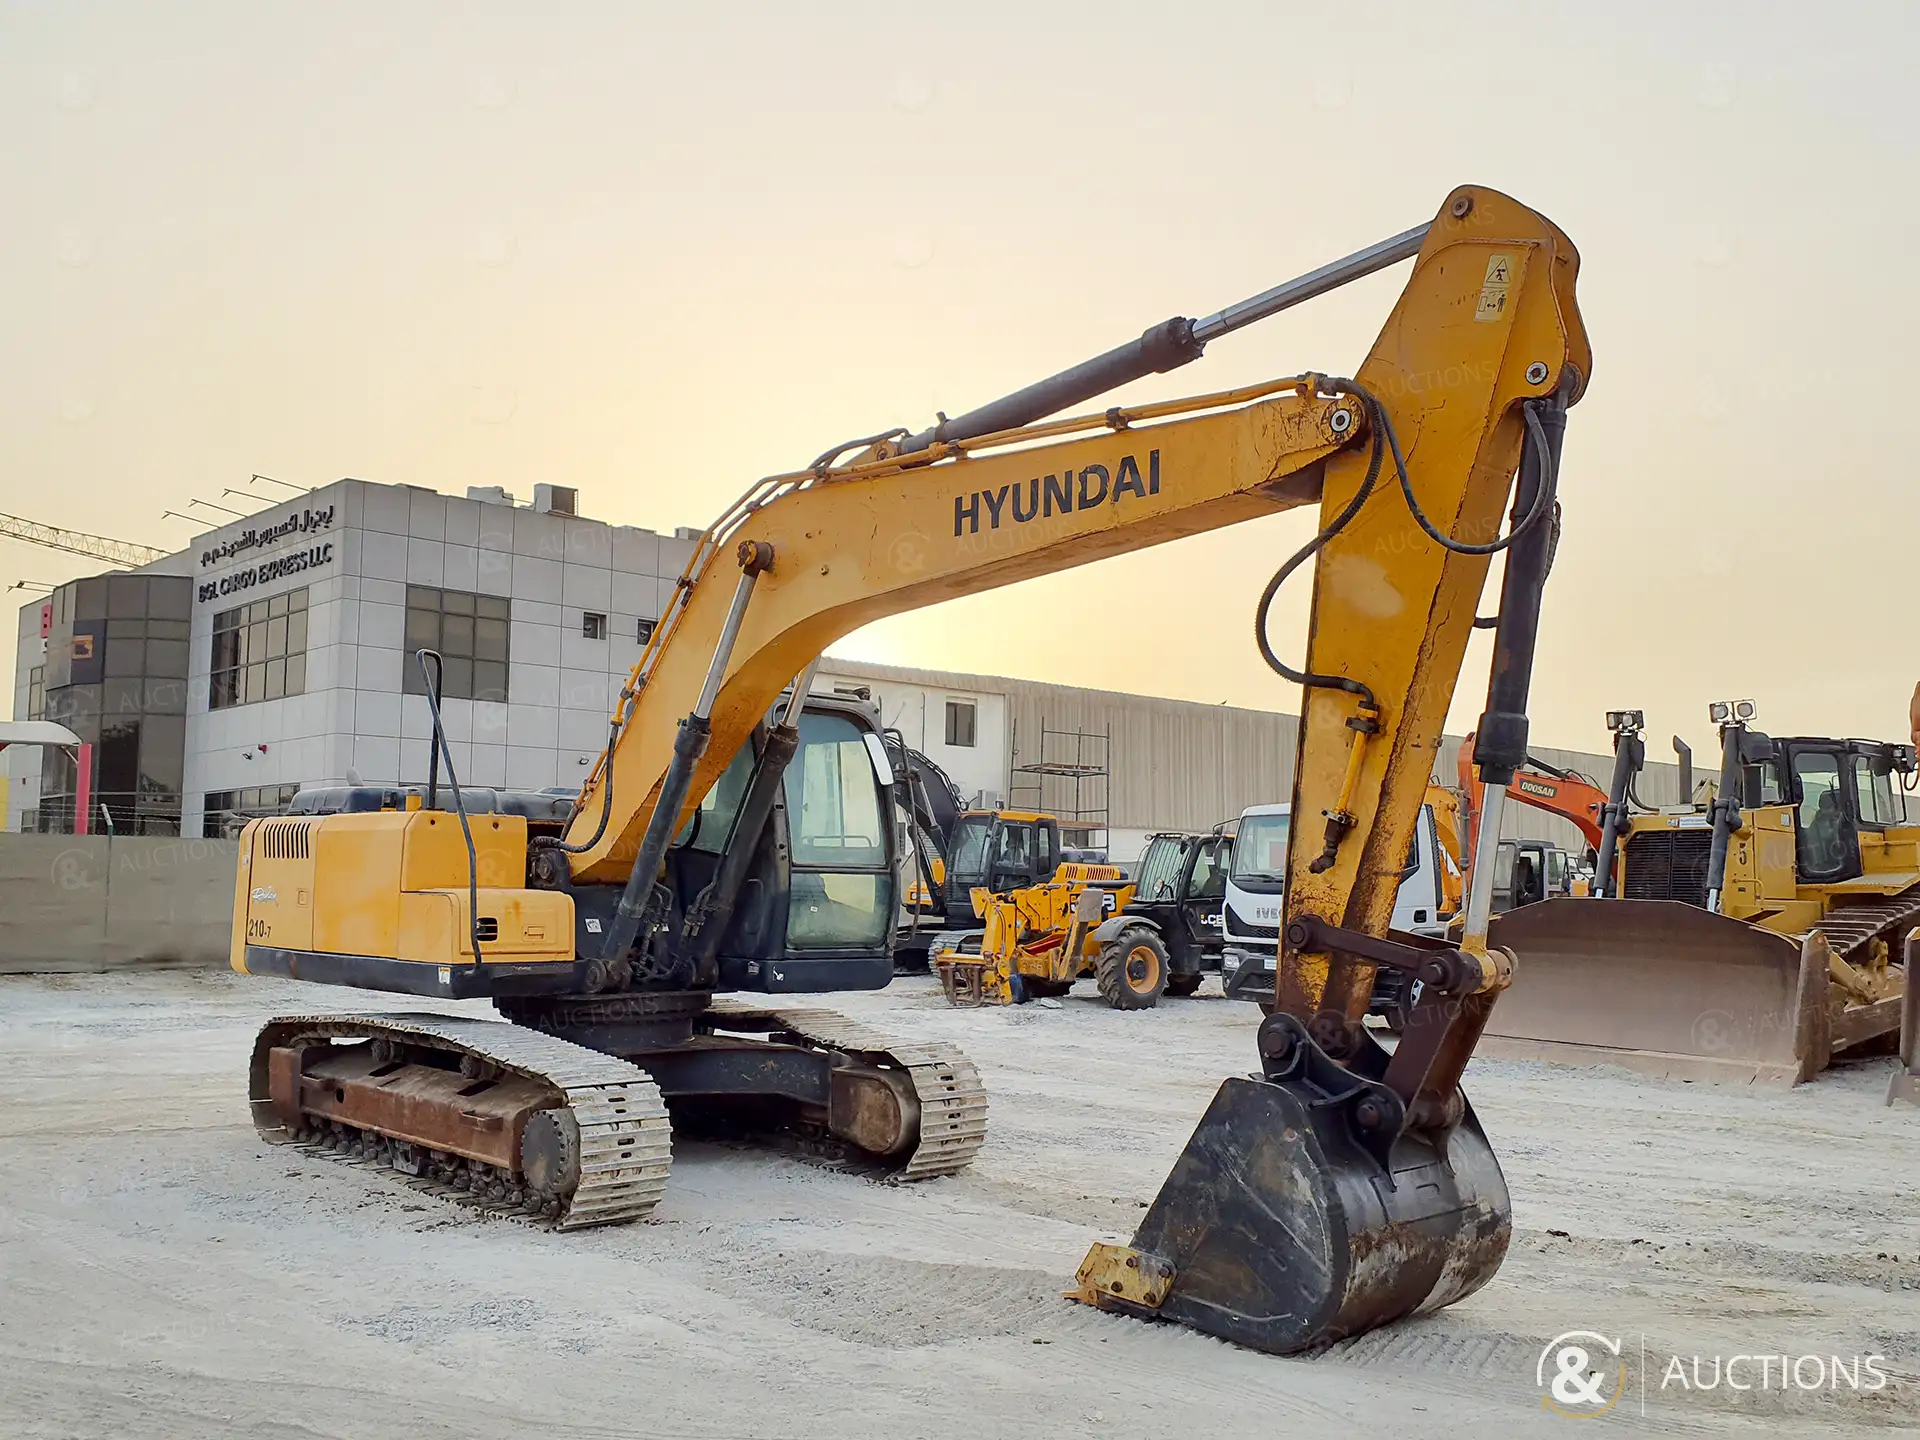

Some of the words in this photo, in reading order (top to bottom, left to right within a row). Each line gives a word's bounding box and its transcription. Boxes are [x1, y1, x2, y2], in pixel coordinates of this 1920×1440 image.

[954, 449, 1160, 537] HYUNDAI
[220, 568, 257, 596] CARGO
[258, 551, 308, 584] EXPRESS
[309, 542, 333, 568] LLC
[1521, 781, 1555, 797] DOOSAN
[1256, 907, 1282, 919] IVE
